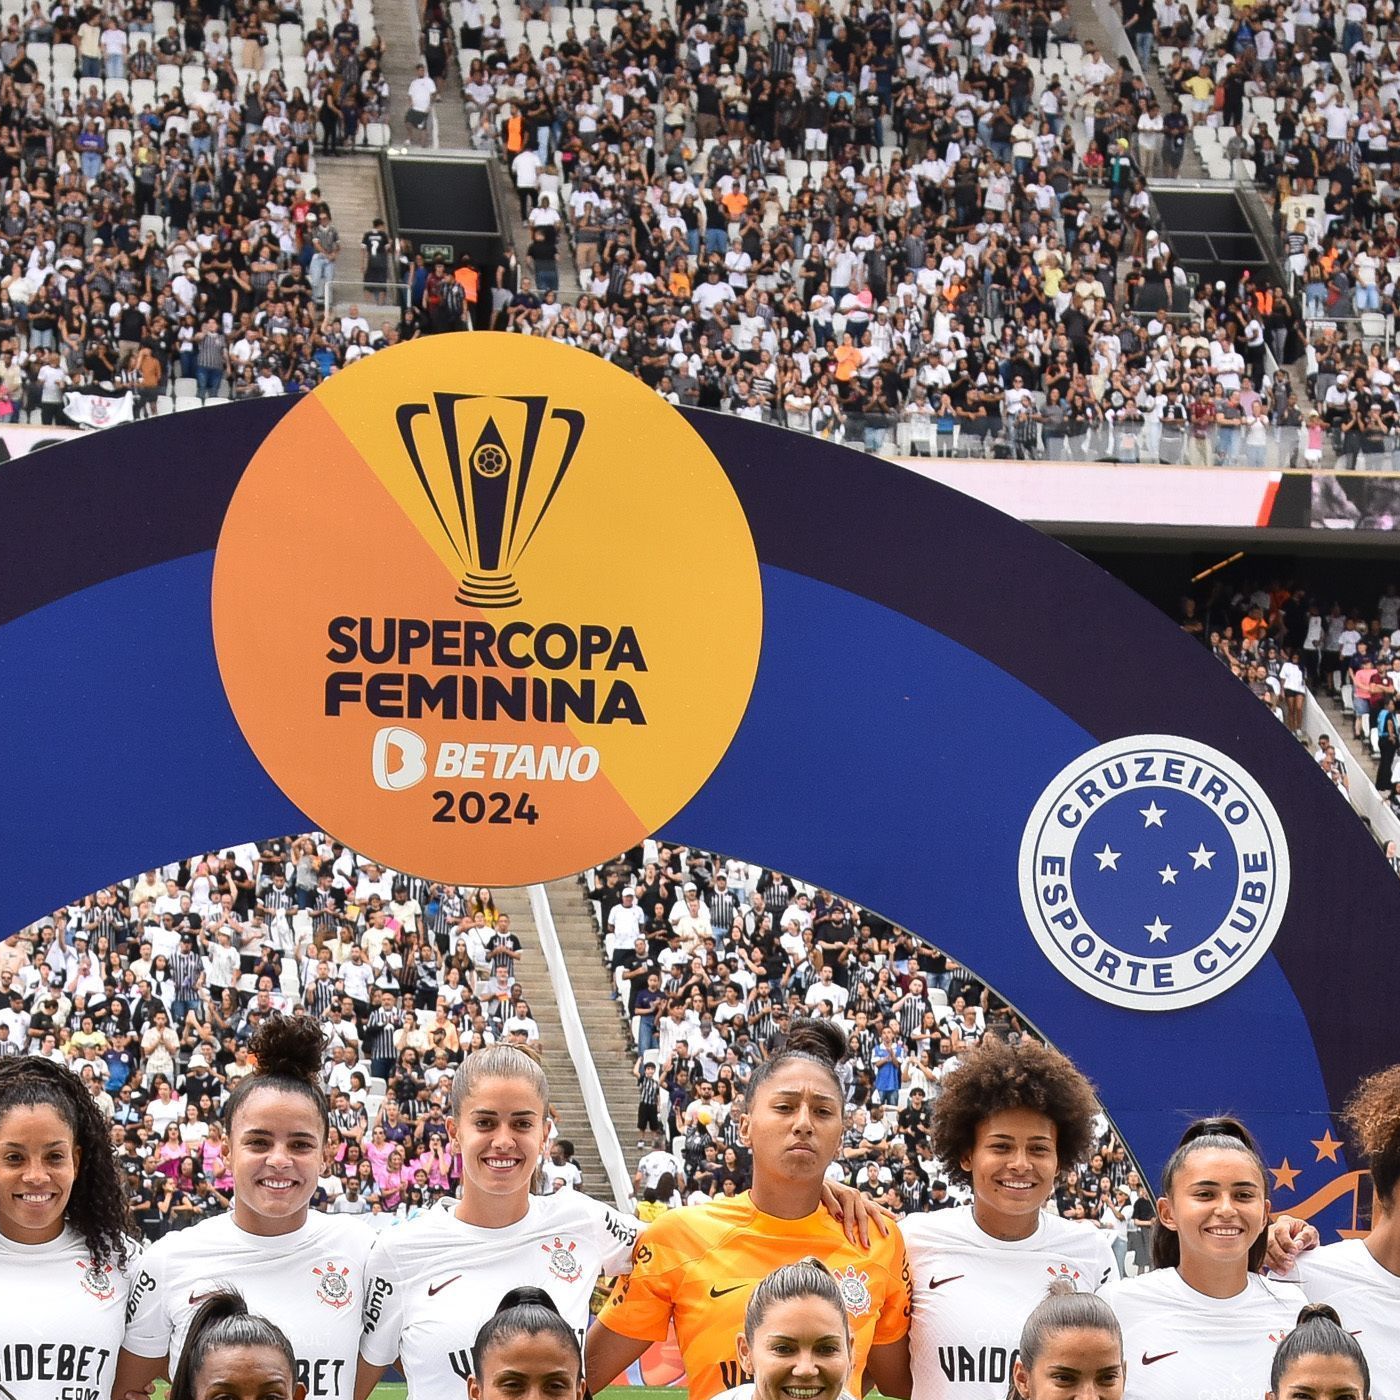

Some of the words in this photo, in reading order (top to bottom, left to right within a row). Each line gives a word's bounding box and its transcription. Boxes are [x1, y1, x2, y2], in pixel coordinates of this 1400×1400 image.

[326, 615, 649, 672] SUPERCOPA
[324, 671, 647, 725] FEMININA
[433, 743, 600, 782] BETANO
[432, 790, 540, 825] 2024
[1057, 757, 1250, 829] CRUZEIRO
[1041, 855, 1175, 988] ESPORTE
[1193, 851, 1269, 975] CLUBE
[129, 1269, 157, 1316] bmg
[367, 1276, 394, 1326] bmg
